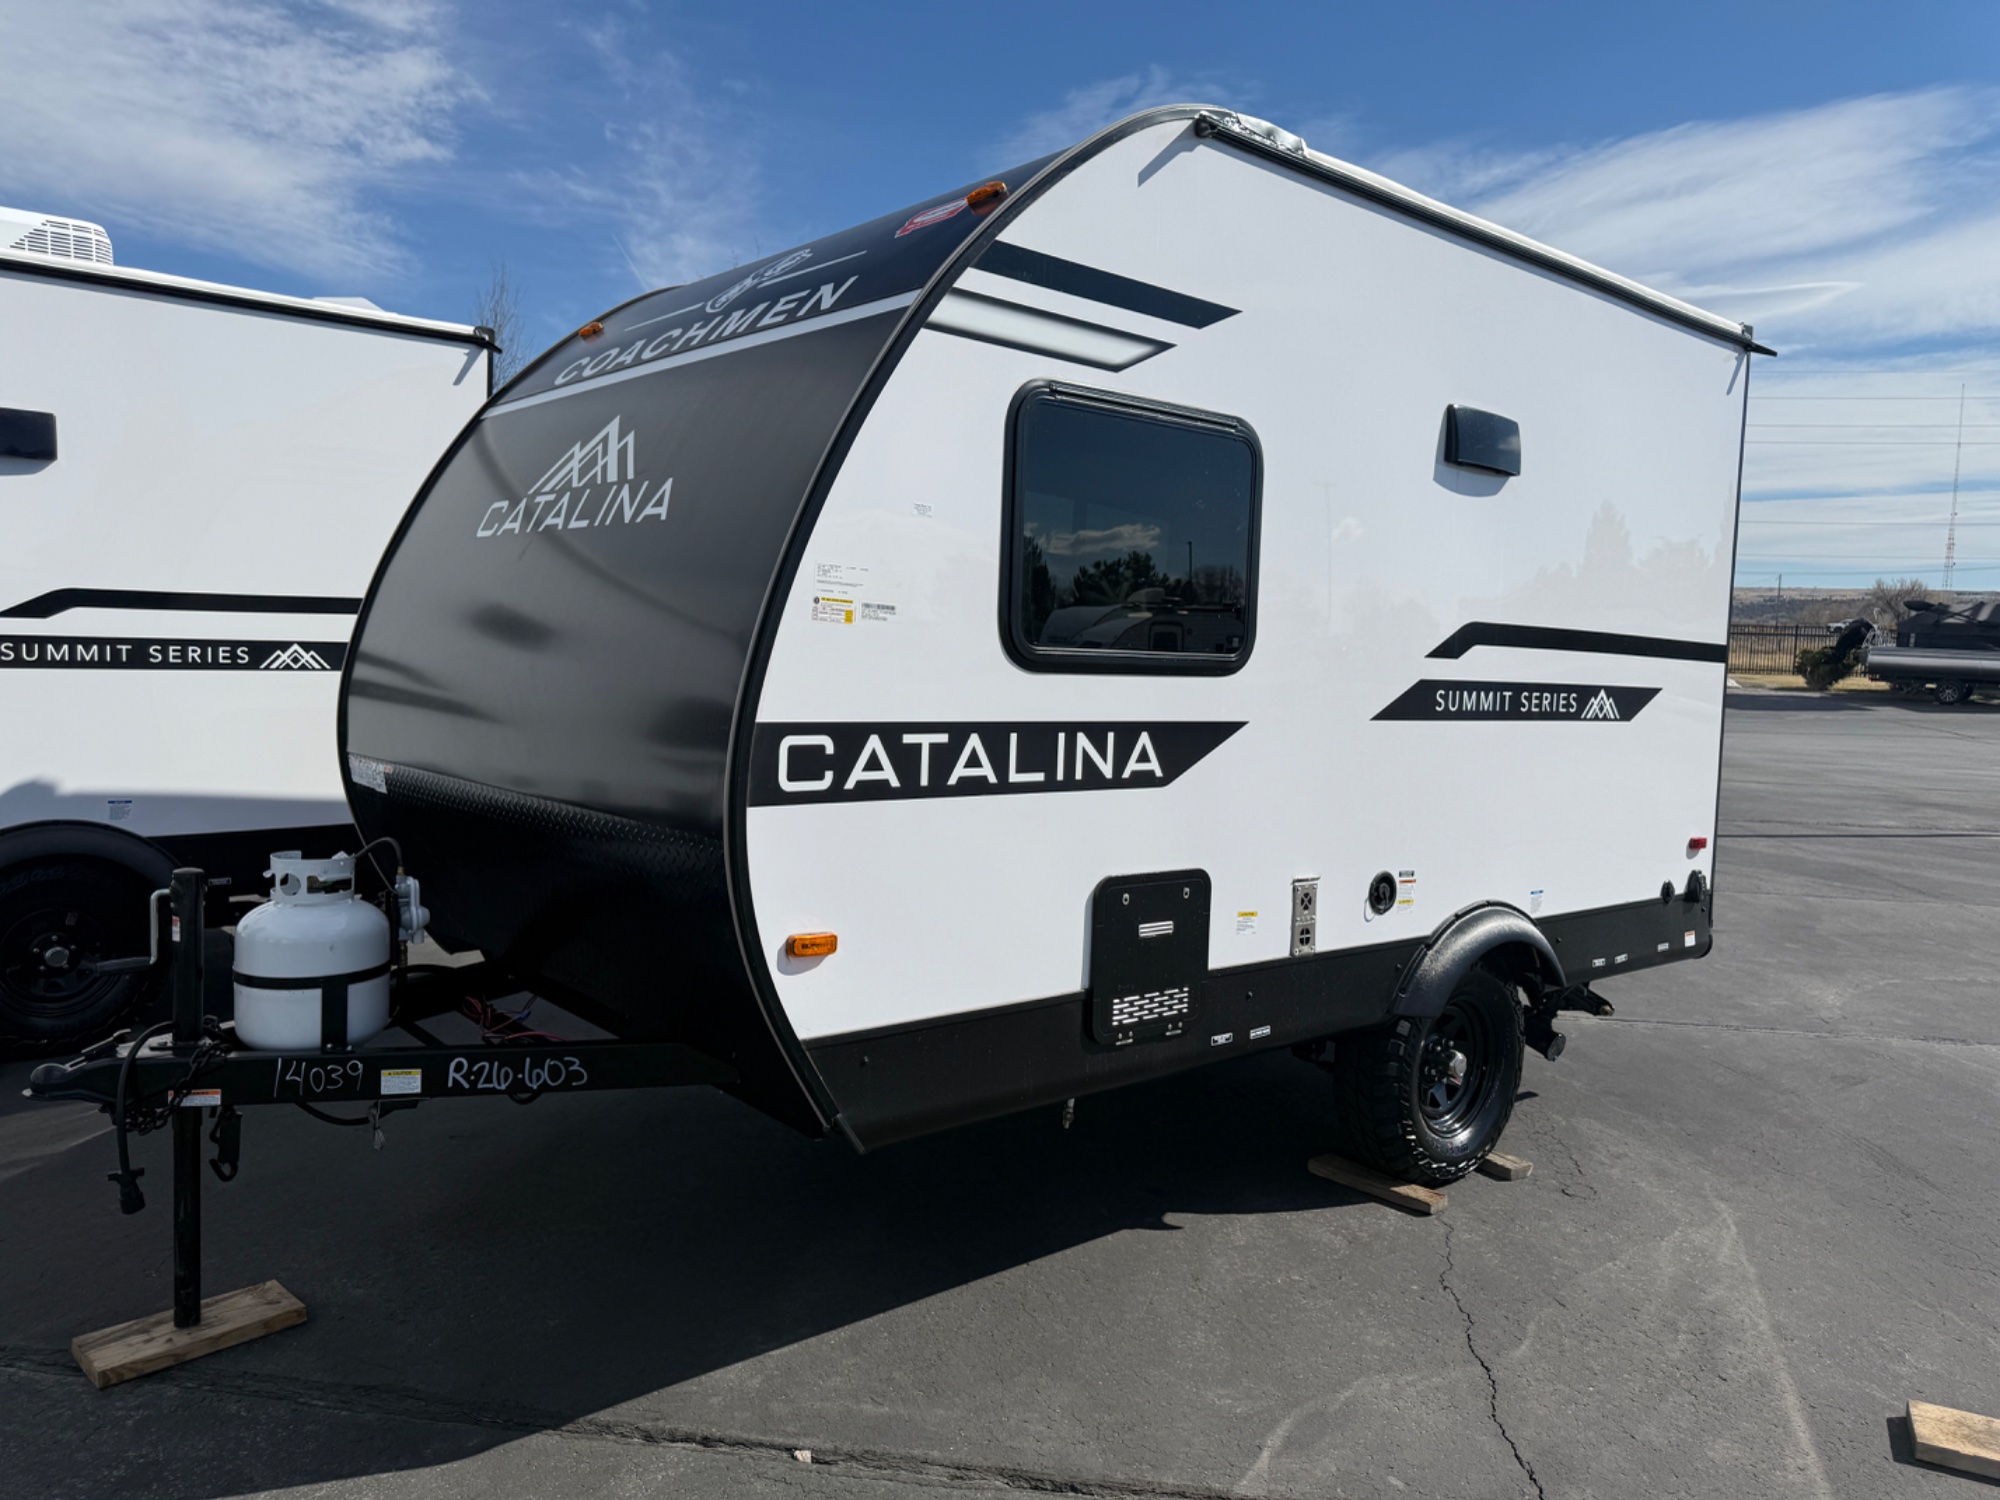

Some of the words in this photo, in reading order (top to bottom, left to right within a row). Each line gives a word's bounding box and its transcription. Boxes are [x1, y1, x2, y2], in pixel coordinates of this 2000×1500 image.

[554, 274, 859, 387] COACHMEN
[476, 477, 674, 538] CATALINA
[0, 642, 133, 662] SUMMIT
[149, 645, 250, 664] SERIES
[1435, 689, 1513, 712] SUMMIT
[1520, 691, 1578, 713] SERIES
[778, 730, 1164, 793] CATALINA
[273, 1057, 364, 1098] 14039
